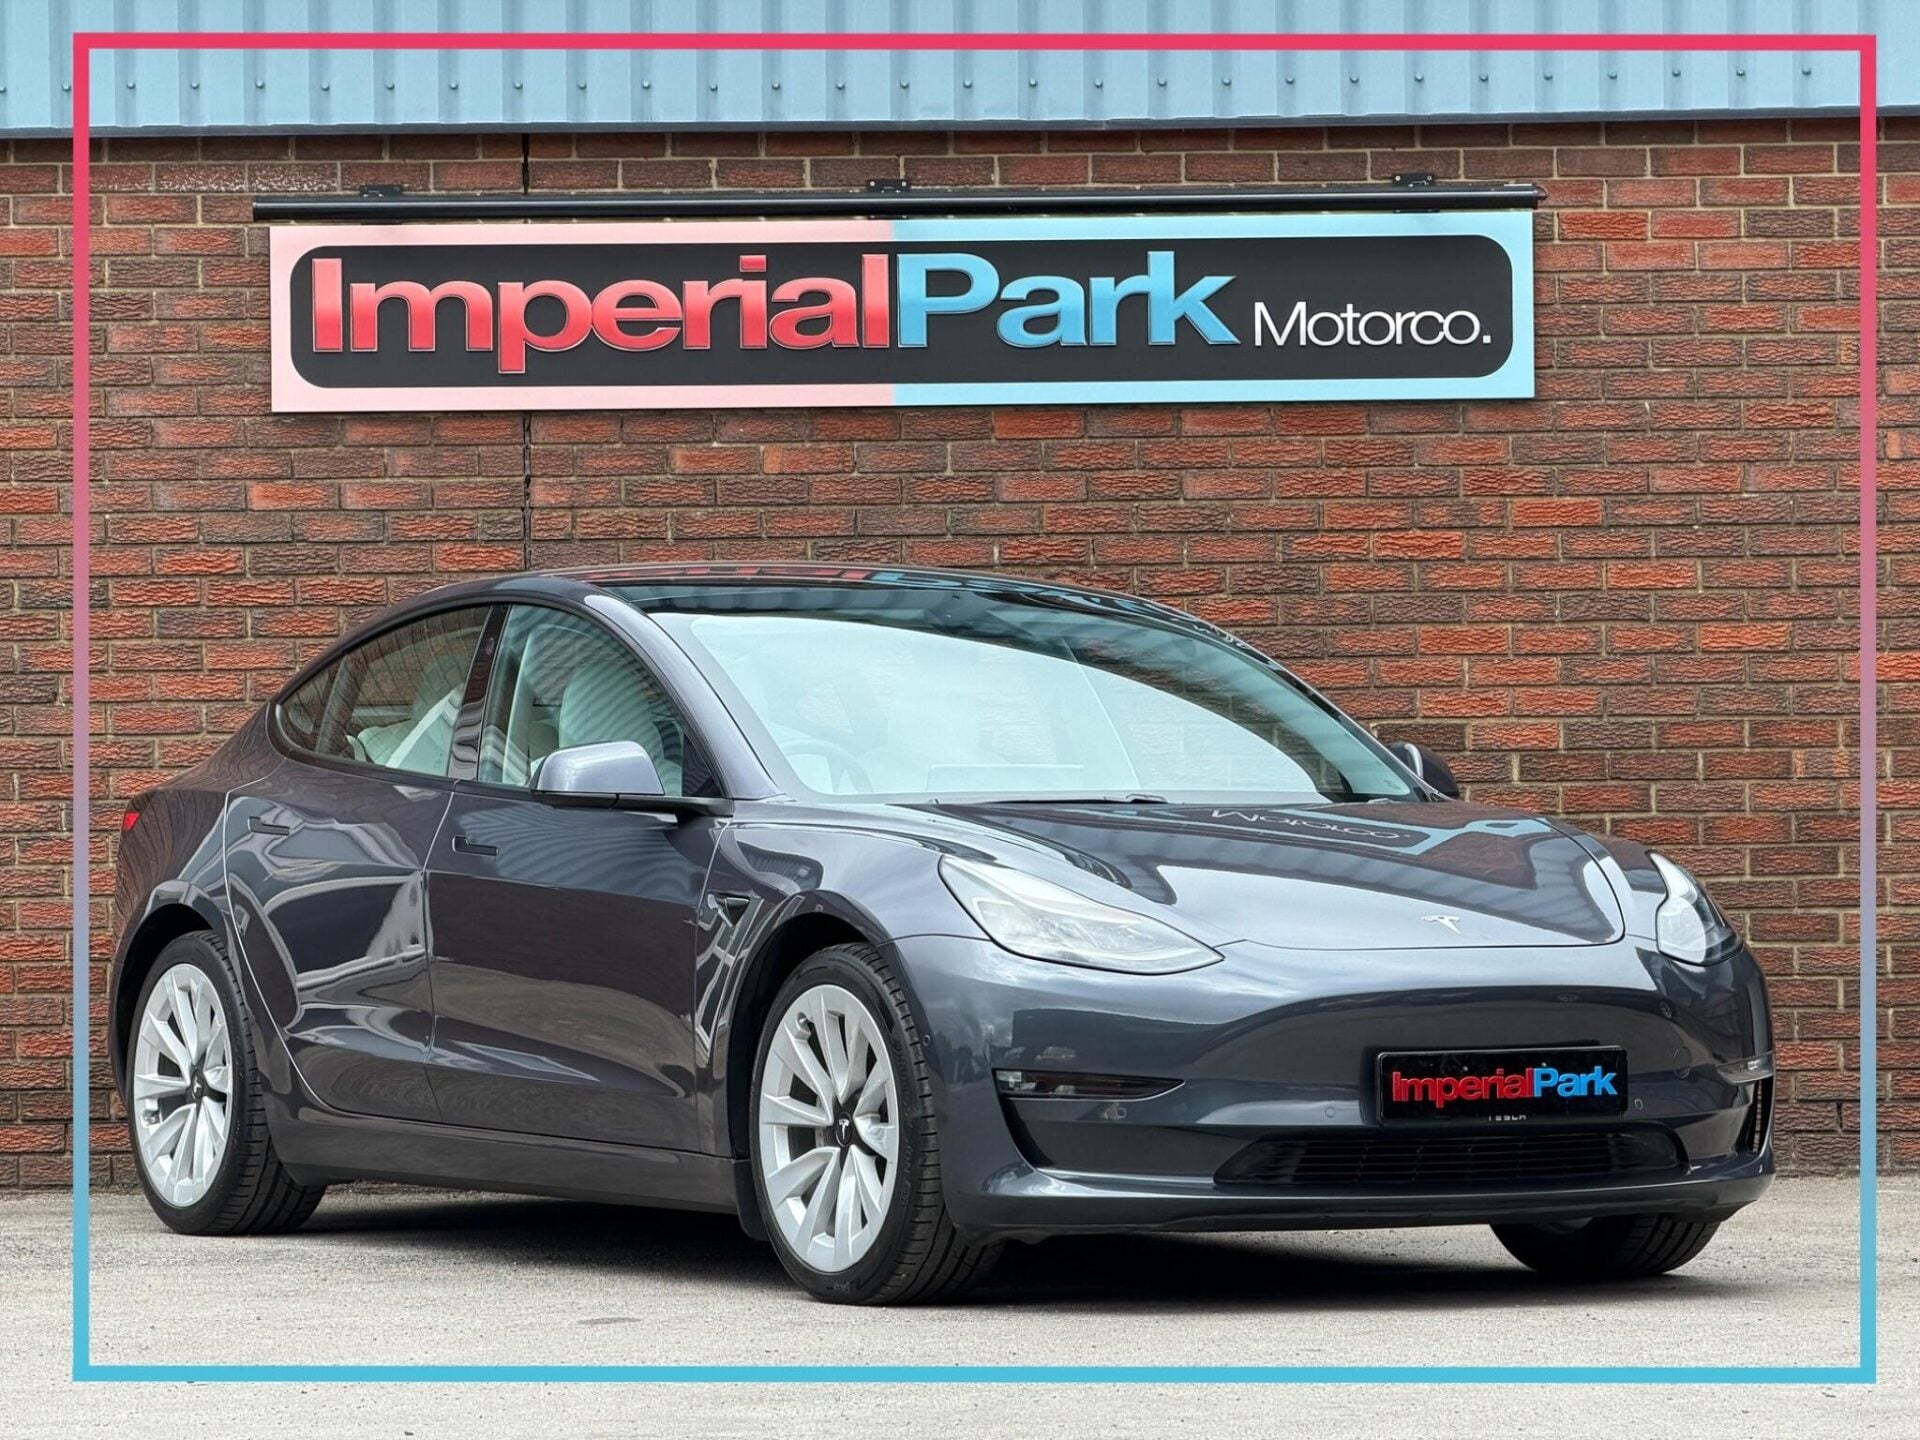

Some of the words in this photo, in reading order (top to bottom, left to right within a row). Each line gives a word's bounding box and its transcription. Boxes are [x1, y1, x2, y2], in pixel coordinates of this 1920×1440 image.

[311, 249, 1241, 374] ImperialPark
[1254, 301, 1492, 347] Motorco.
[1392, 1066, 1618, 1108] ImperialPark
